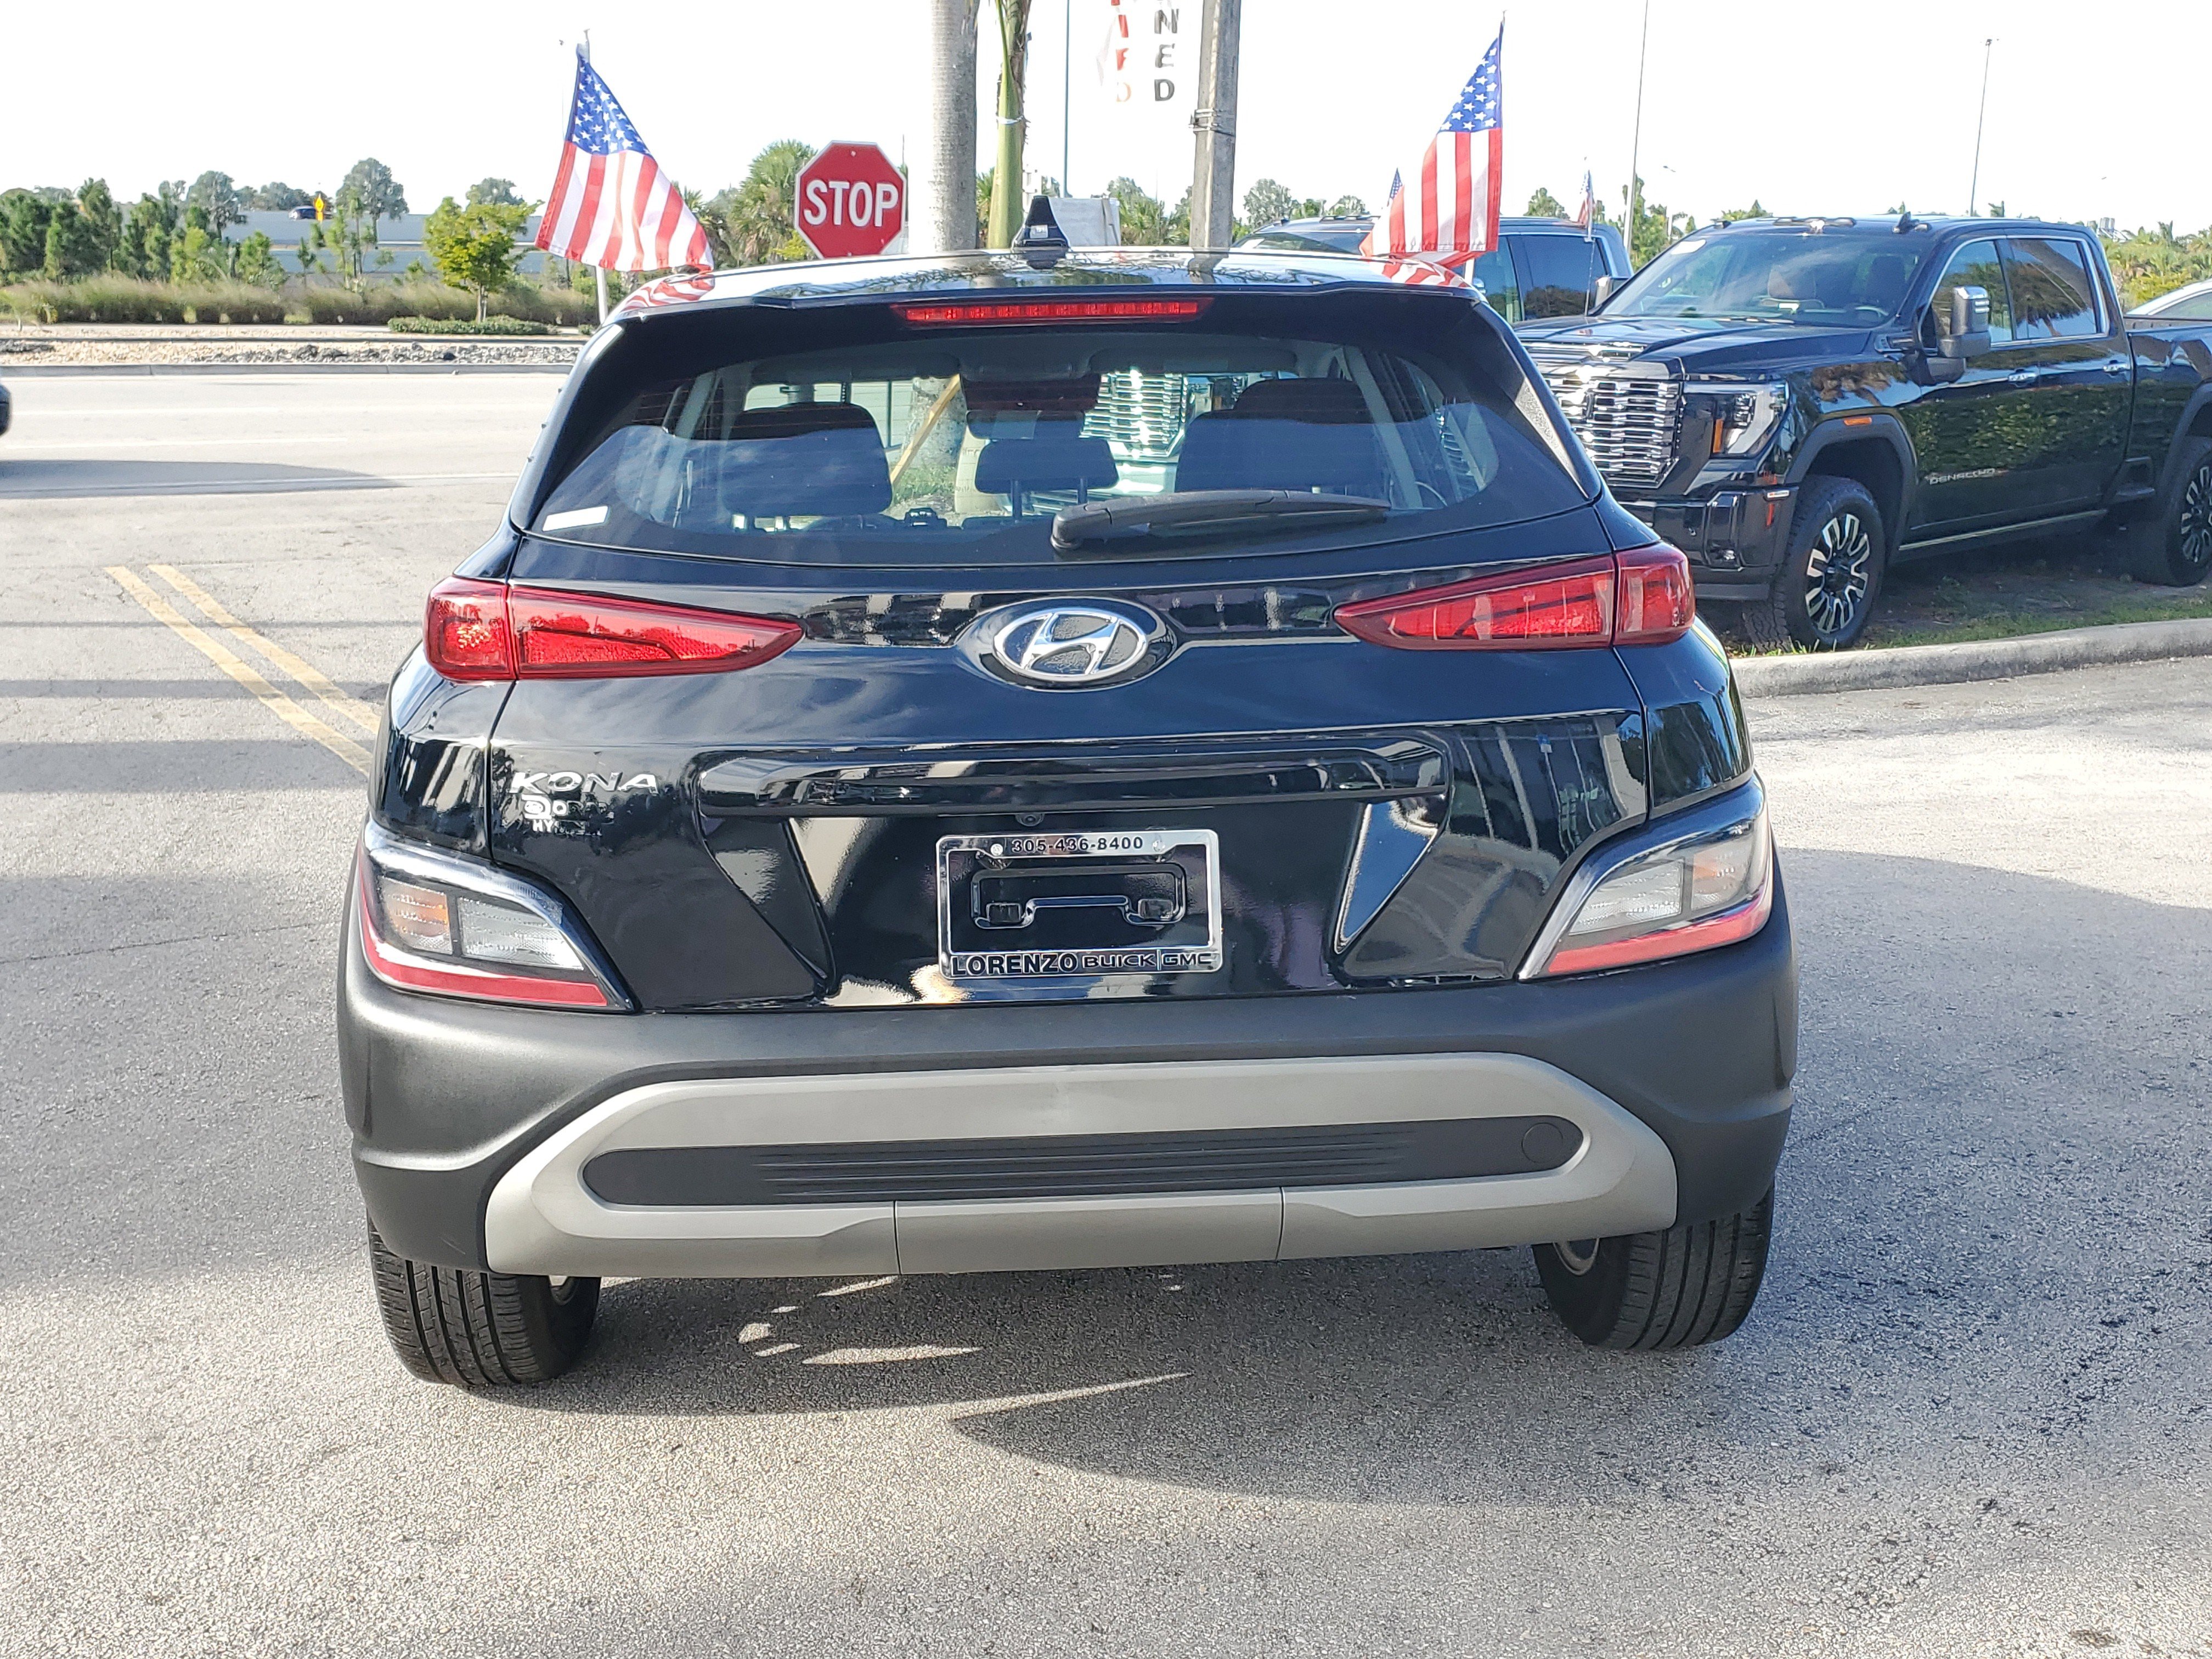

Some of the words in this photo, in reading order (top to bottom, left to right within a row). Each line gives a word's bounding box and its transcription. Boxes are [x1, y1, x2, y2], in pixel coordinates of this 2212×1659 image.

[1154, 0, 1178, 101] NED
[803, 179, 899, 227] STOP
[509, 771, 659, 794] KONA
[1011, 836, 1144, 853] 305-436-8400
[950, 952, 1079, 977] LORENZO
[1082, 956, 1155, 969] BUICK
[1162, 953, 1212, 967] GMC
